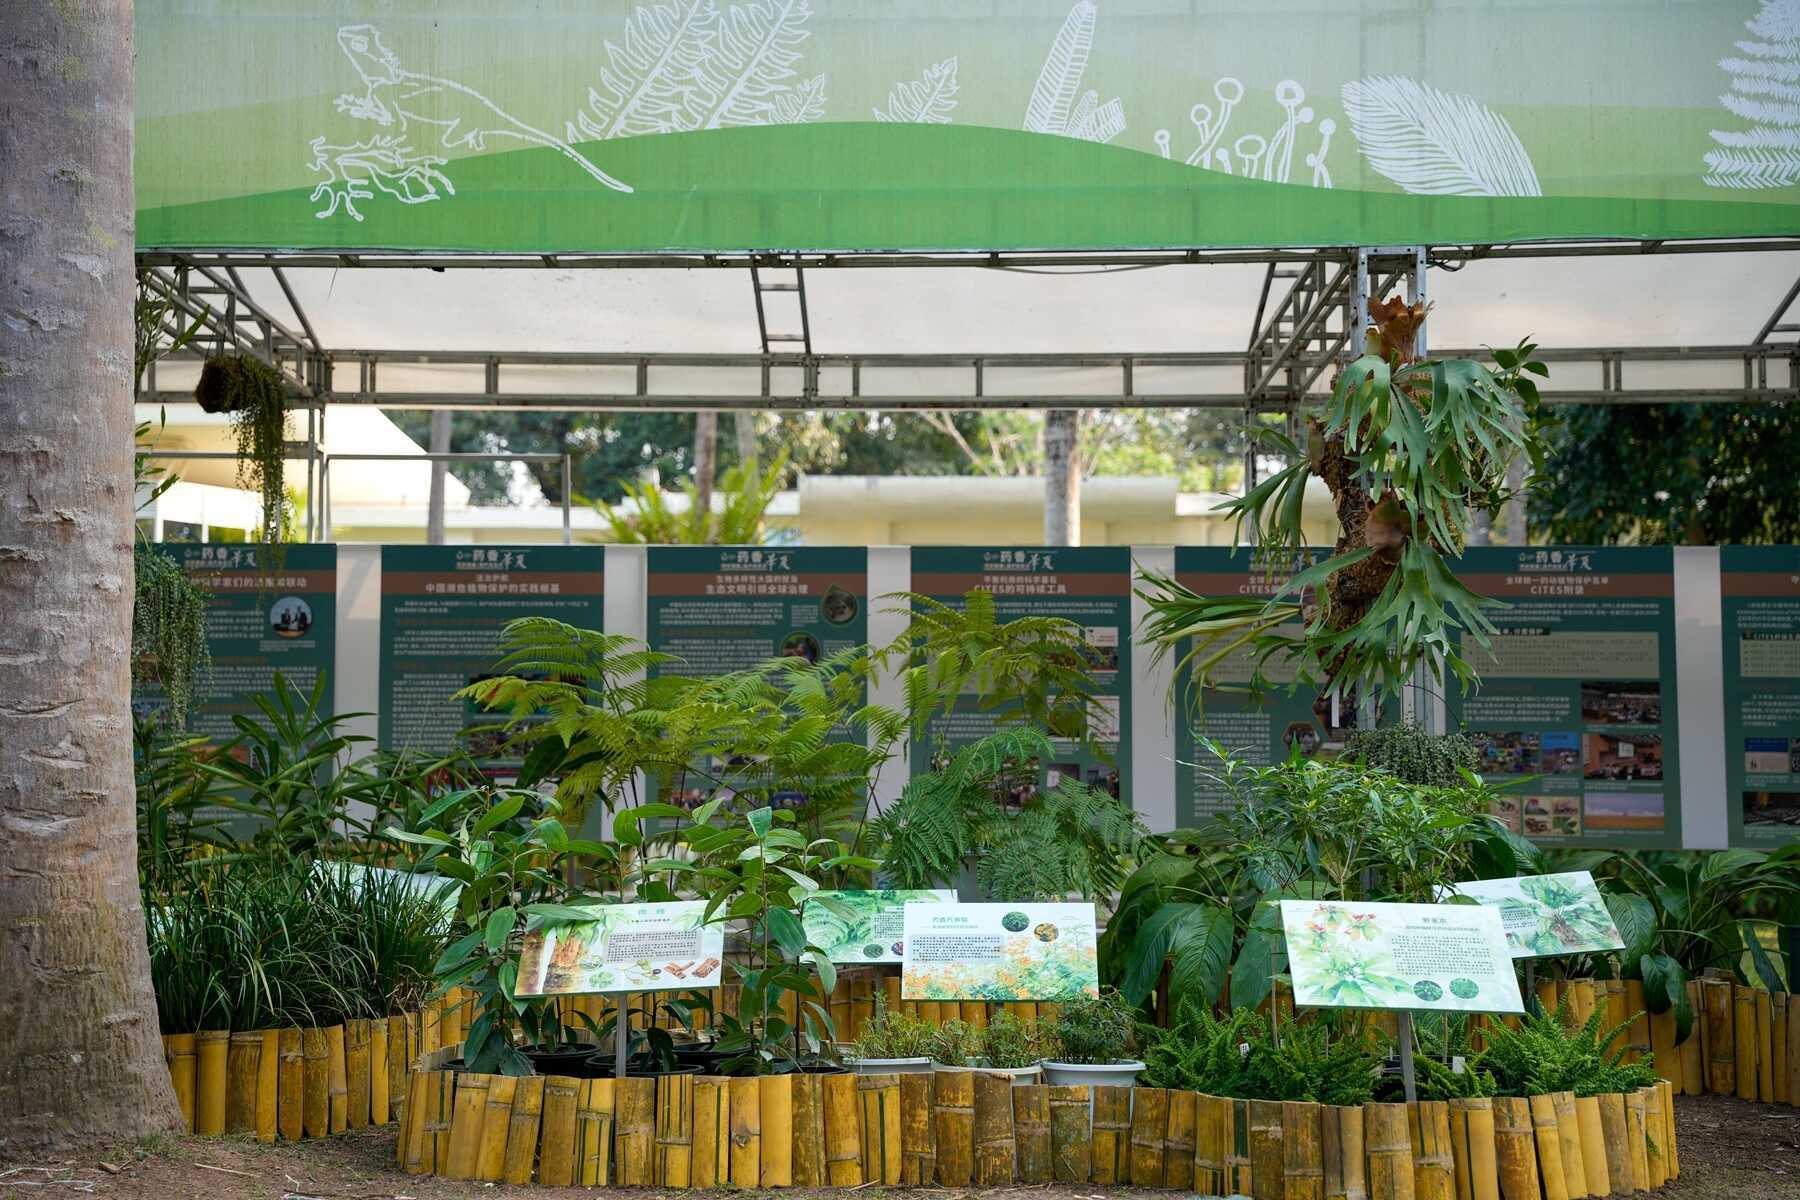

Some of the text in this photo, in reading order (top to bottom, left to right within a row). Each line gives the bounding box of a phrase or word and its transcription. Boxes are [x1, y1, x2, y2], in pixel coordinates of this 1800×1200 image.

[705, 584, 809, 595] 生态文明引领全球治理
[1530, 585, 1584, 595] CITES附录
